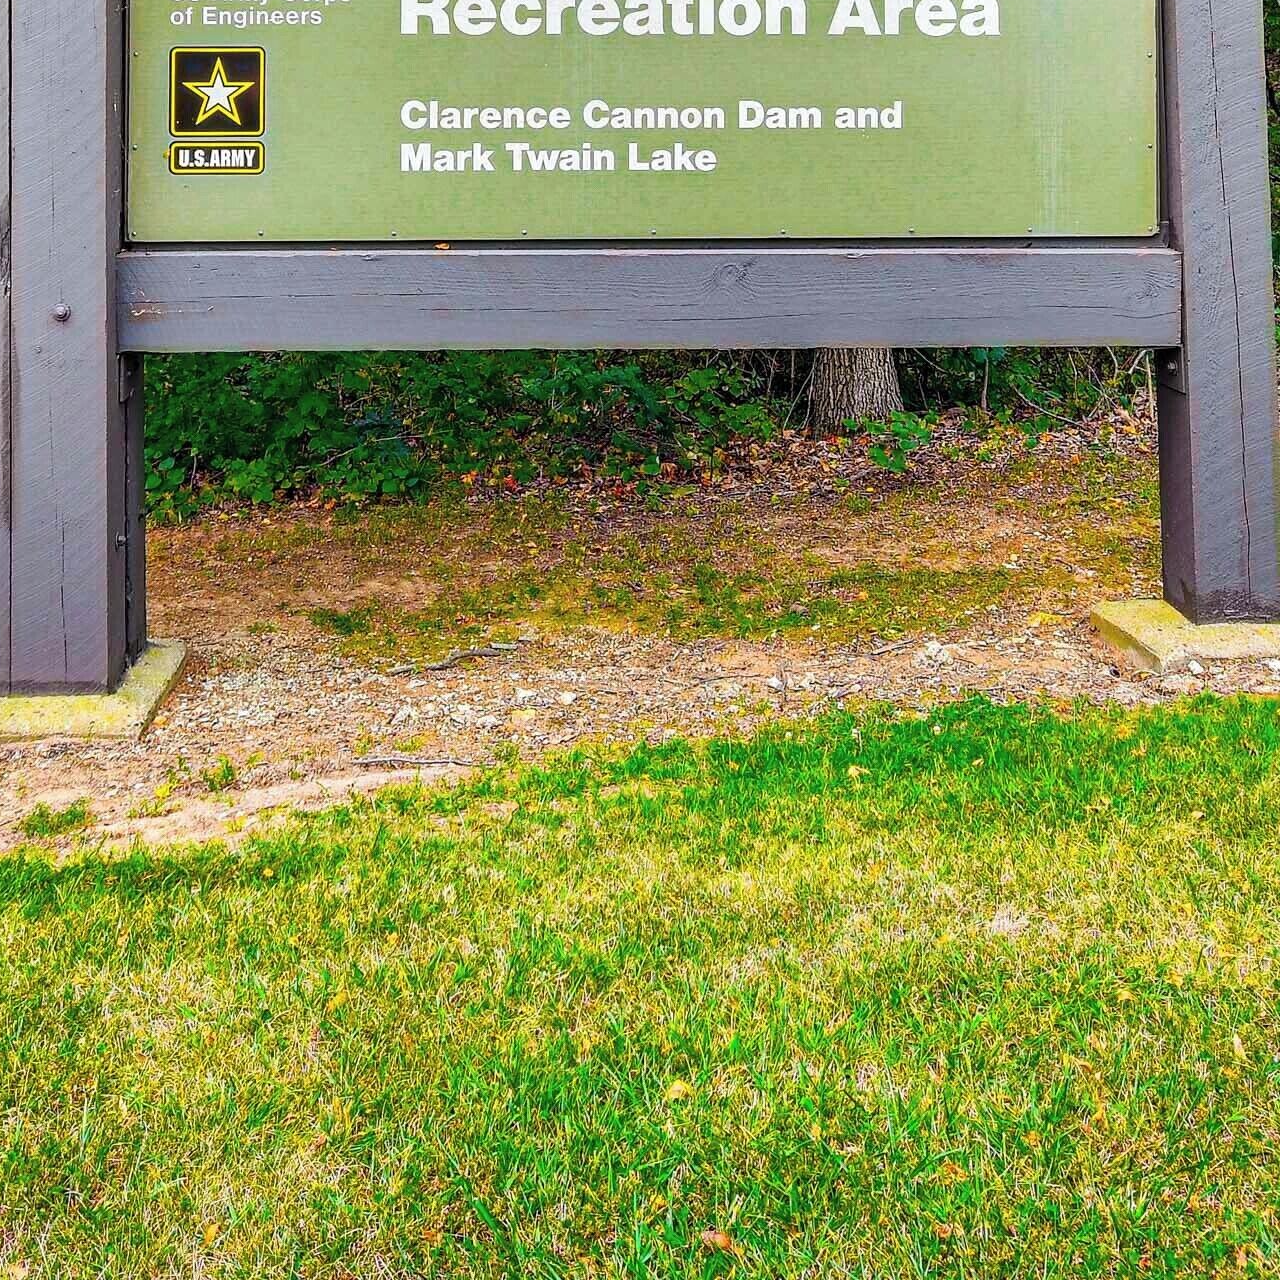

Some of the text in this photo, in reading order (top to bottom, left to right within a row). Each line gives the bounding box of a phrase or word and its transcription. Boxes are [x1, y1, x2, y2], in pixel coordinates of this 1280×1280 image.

[169, 6, 323, 28] of Engineers
[400, 99, 904, 130] Clarence Cannon Dam and
[400, 142, 718, 173] Mark Twain Lake
